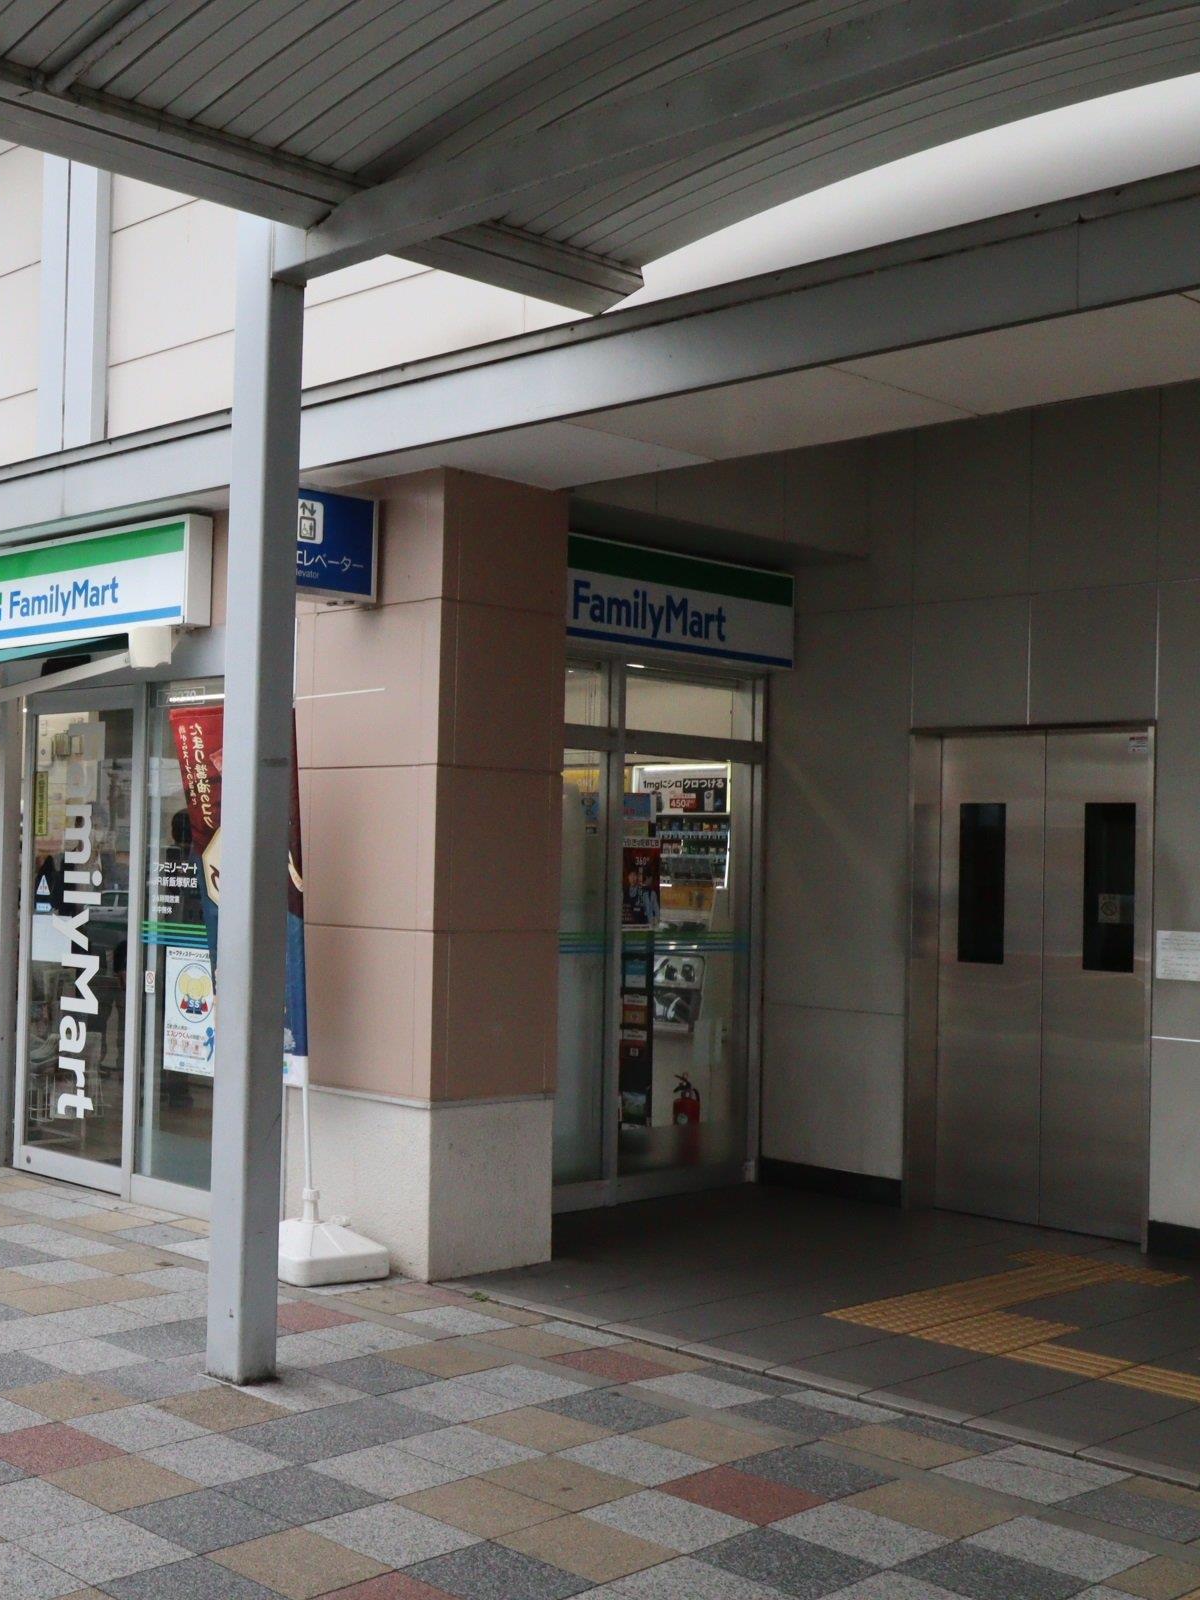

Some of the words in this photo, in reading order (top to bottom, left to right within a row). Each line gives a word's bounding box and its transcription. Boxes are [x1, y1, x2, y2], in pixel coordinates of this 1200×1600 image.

[296, 567, 320, 579] levator
[9, 576, 119, 619] FamilyMart
[573, 579, 726, 642] FamilyMart
[152, 862, 198, 875] ファミリーマート
[52, 719, 106, 1120] FamilyMart
